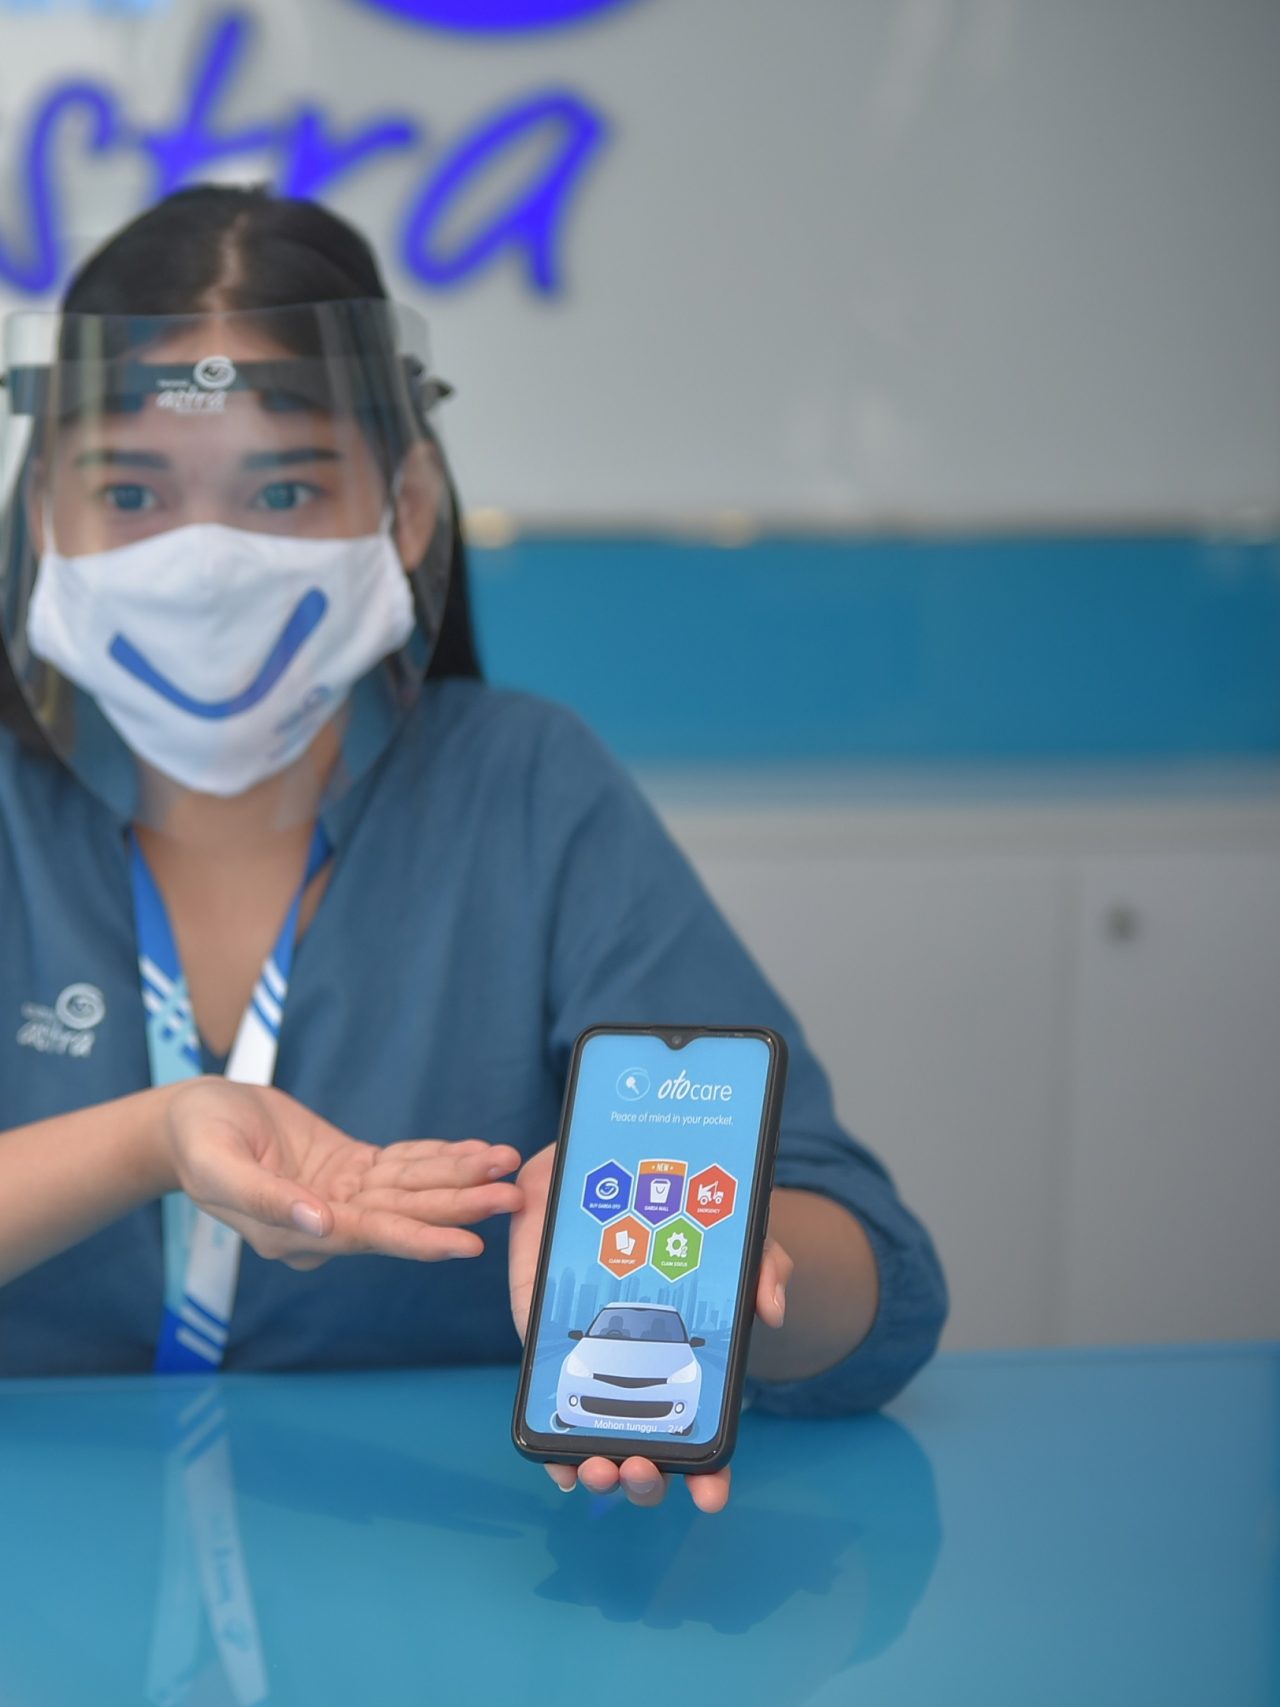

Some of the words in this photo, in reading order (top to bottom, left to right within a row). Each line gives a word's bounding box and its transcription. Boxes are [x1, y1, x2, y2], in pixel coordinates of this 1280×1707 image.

[657, 1069, 733, 1101] otocare
[611, 1111, 637, 1122] Peace
[639, 1112, 648, 1122] of
[649, 1113, 671, 1124] mind
[672, 1113, 680, 1124] in
[682, 1114, 701, 1127] your
[594, 1420, 624, 1430] Mohon
[626, 1422, 657, 1434] tunggu
